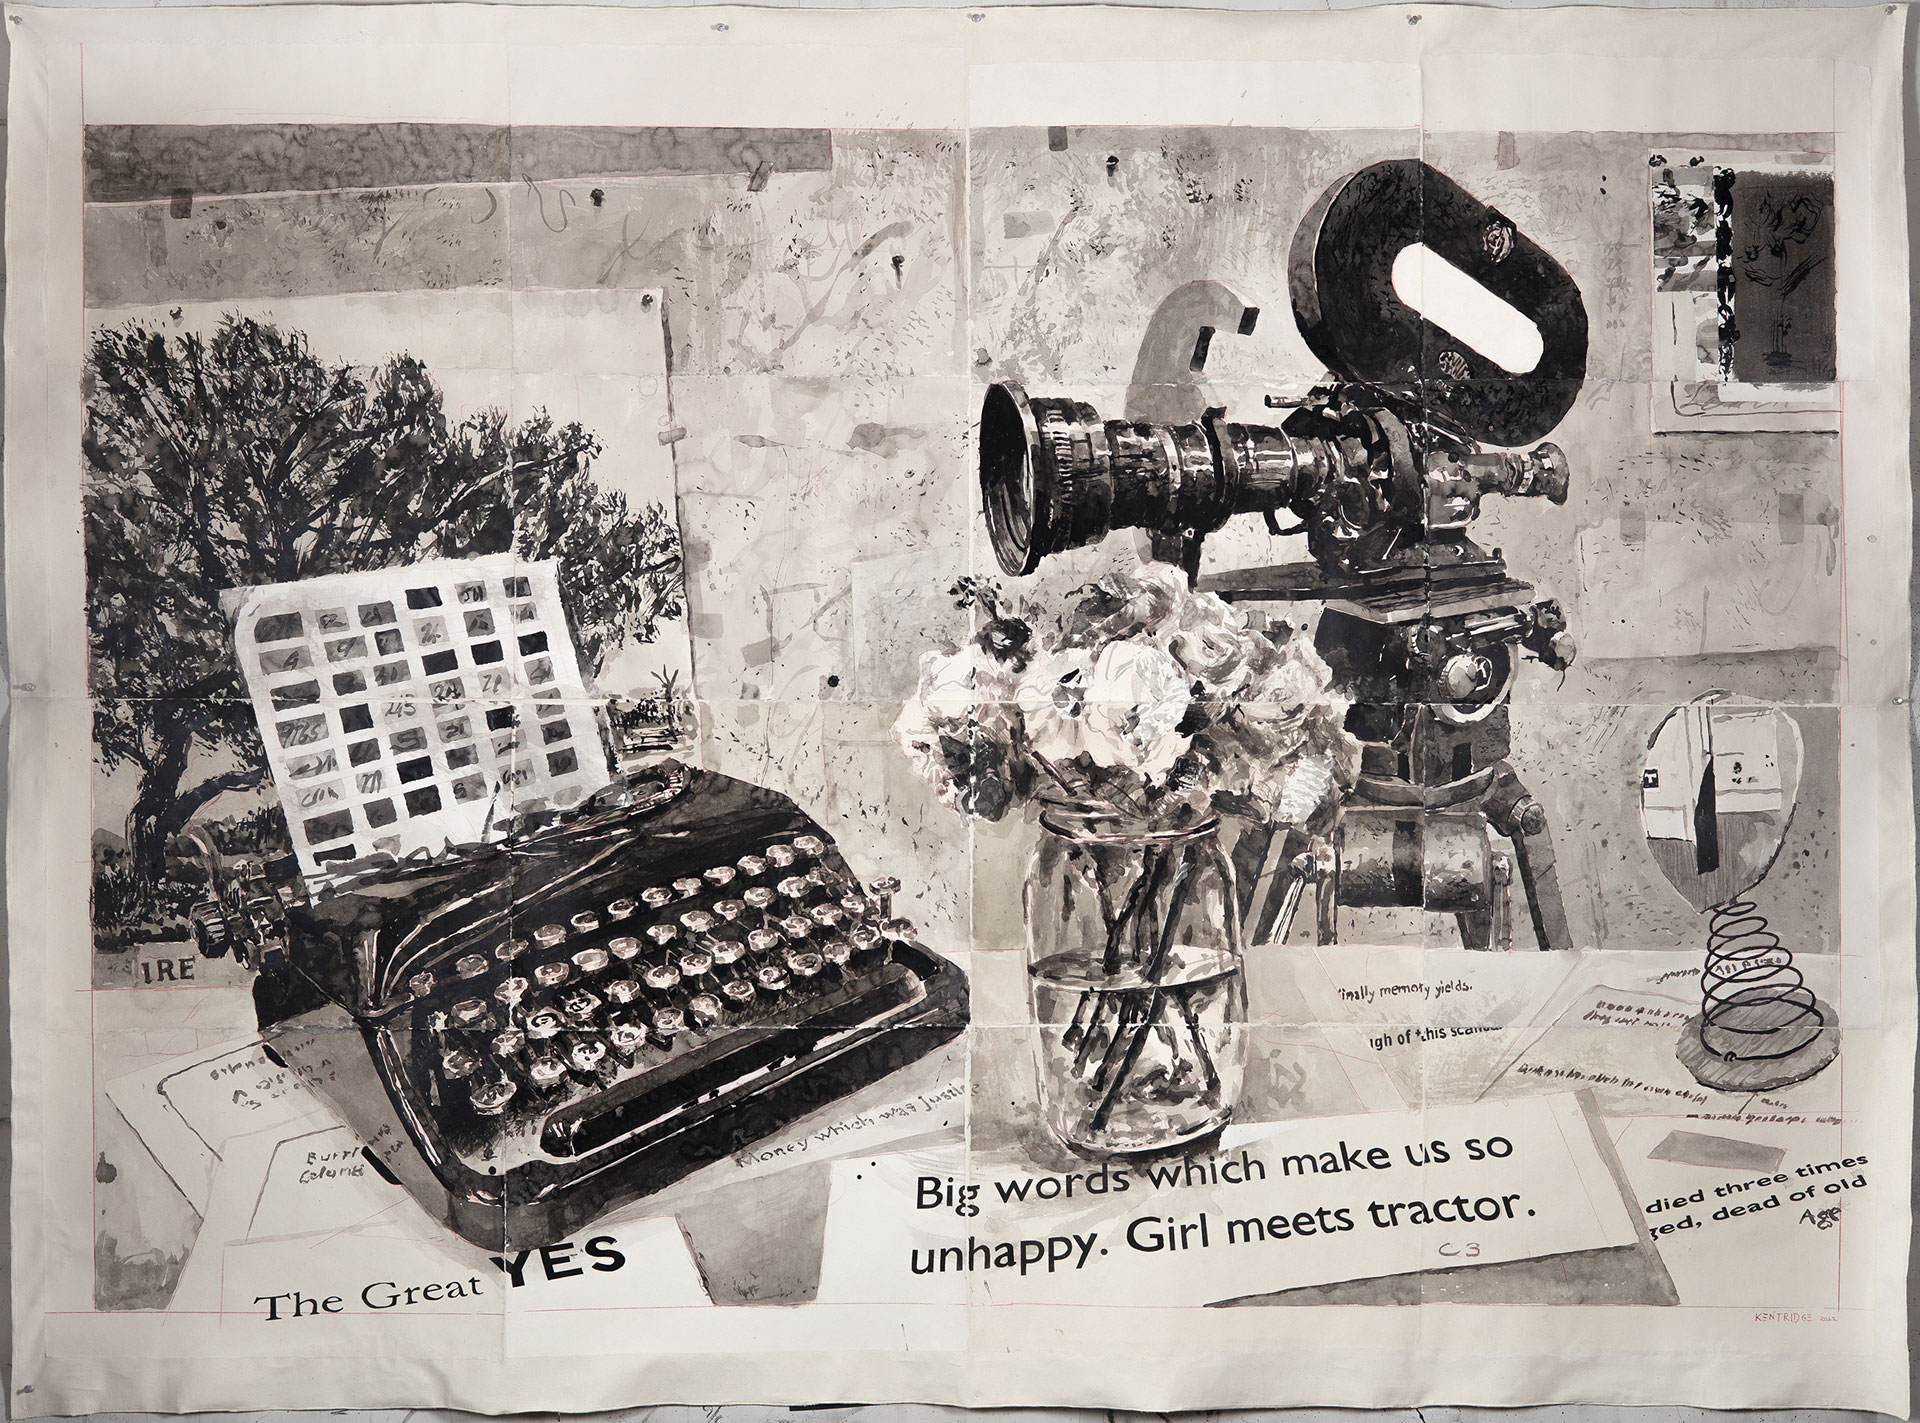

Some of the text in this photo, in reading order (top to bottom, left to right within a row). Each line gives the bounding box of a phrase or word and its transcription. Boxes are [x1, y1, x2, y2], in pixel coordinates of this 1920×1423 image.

[140, 954, 196, 985] IRE
[1338, 979, 1473, 1004] inally memory yields.
[1397, 1029, 1411, 1045] of
[734, 1138, 809, 1169] Money
[814, 1114, 875, 1142] which
[916, 1136, 1513, 1217] Big words which make us so
[1645, 1155, 1869, 1214] died three times
[1712, 1195, 1781, 1221] dead
[1789, 1185, 1816, 1202] of
[1824, 1174, 1868, 1195] old
[911, 1193, 1536, 1276] unhappy. Girl meets tractor.
[1799, 1205, 1842, 1231] Age
[253, 1235, 626, 1321] The Great YES
[1754, 1312, 1813, 1324] KENTRIDGE
